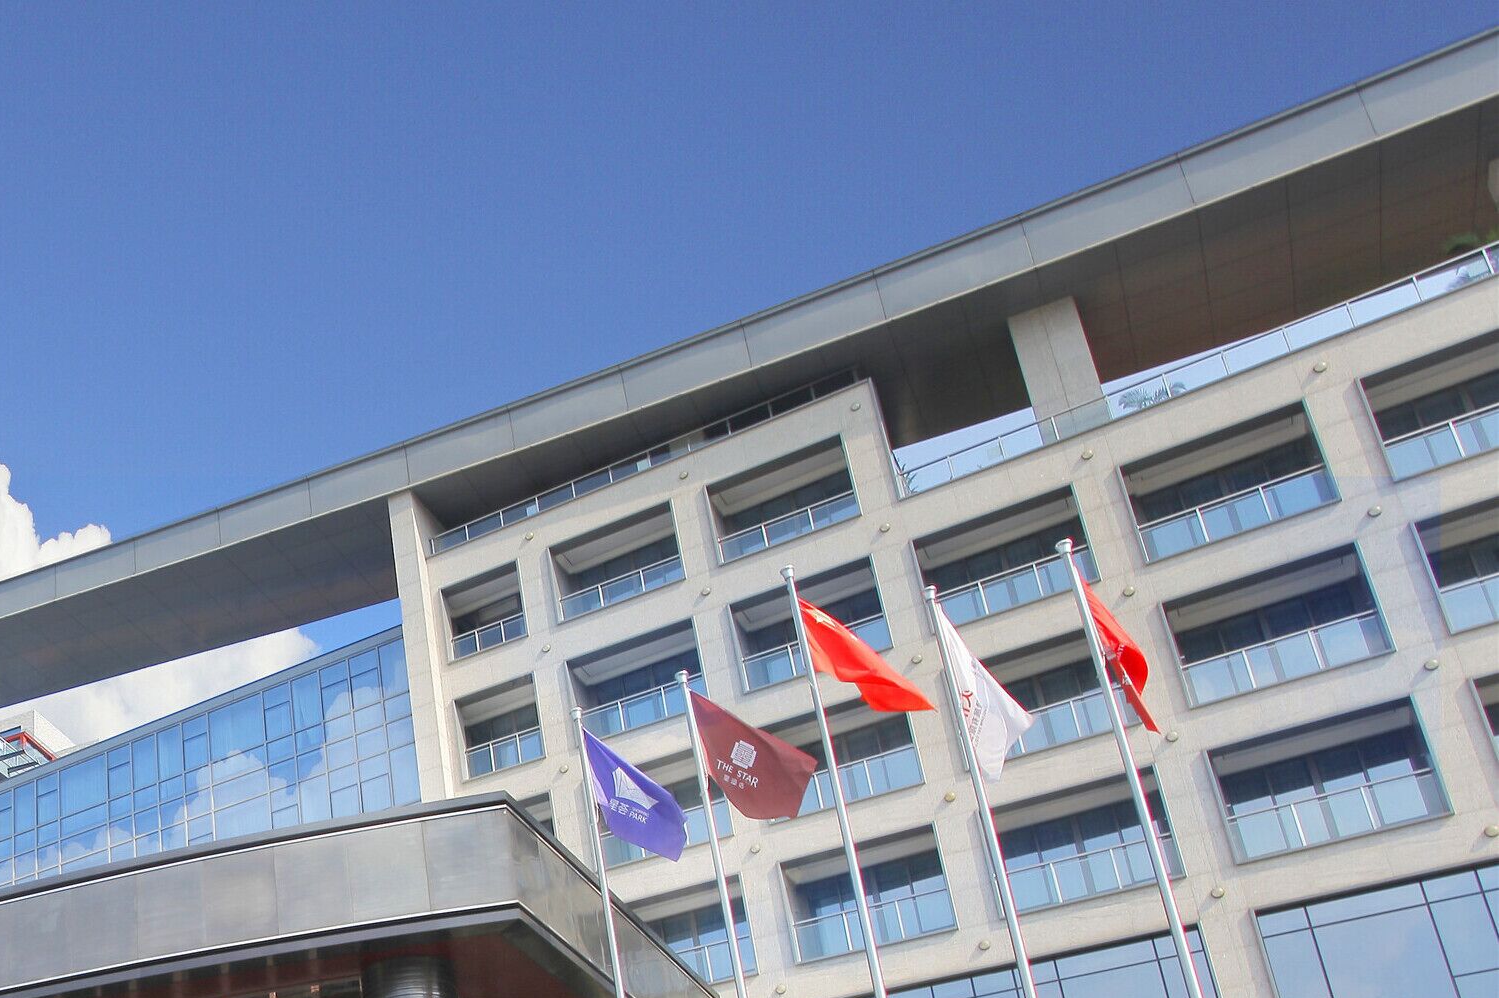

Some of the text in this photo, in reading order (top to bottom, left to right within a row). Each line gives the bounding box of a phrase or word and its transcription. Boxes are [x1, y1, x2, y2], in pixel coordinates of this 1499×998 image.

[716, 758, 734, 774] THE
[736, 770, 759, 788] STAR
[629, 811, 648, 824] PARK
